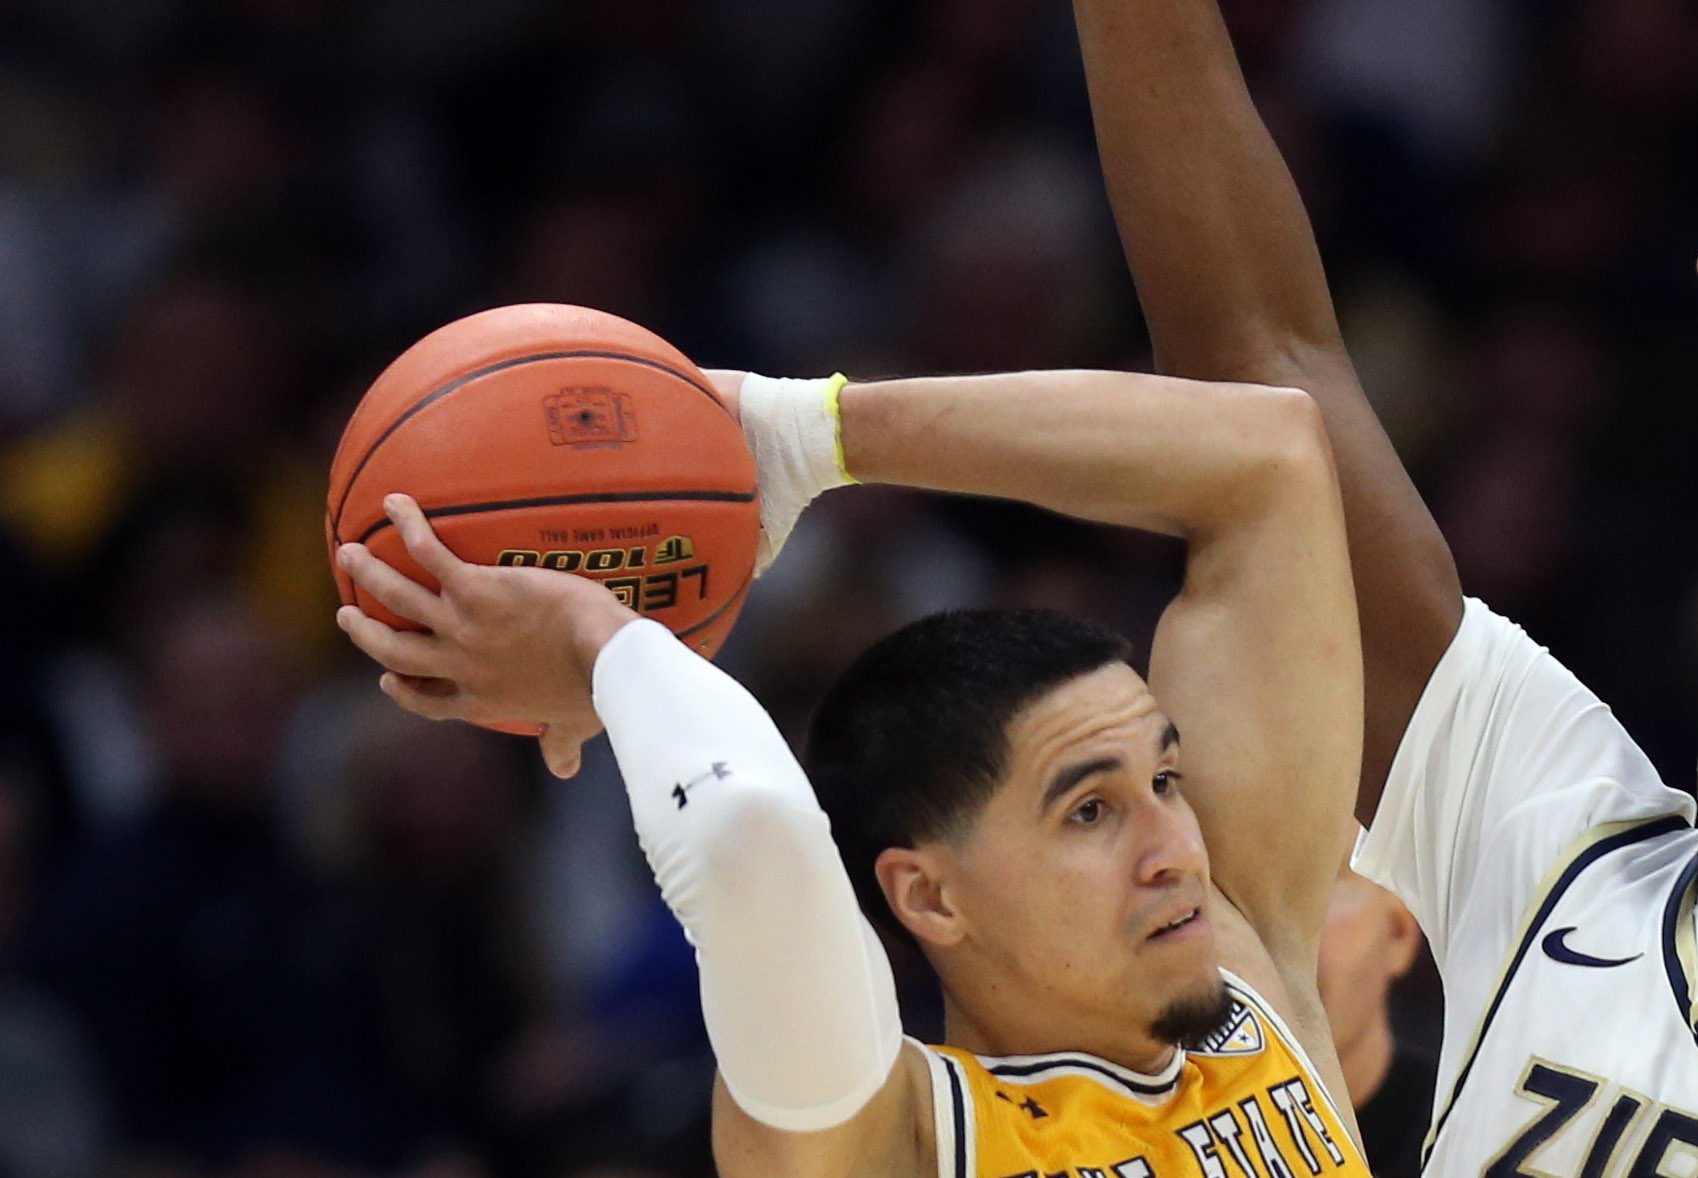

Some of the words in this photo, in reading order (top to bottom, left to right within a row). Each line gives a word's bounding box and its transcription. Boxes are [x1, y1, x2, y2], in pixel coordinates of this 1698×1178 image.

[538, 529, 569, 544] BALL
[571, 528, 605, 543] GAME
[609, 523, 660, 542] OFFICIAL
[496, 546, 647, 573] 1000
[654, 534, 695, 567] TF
